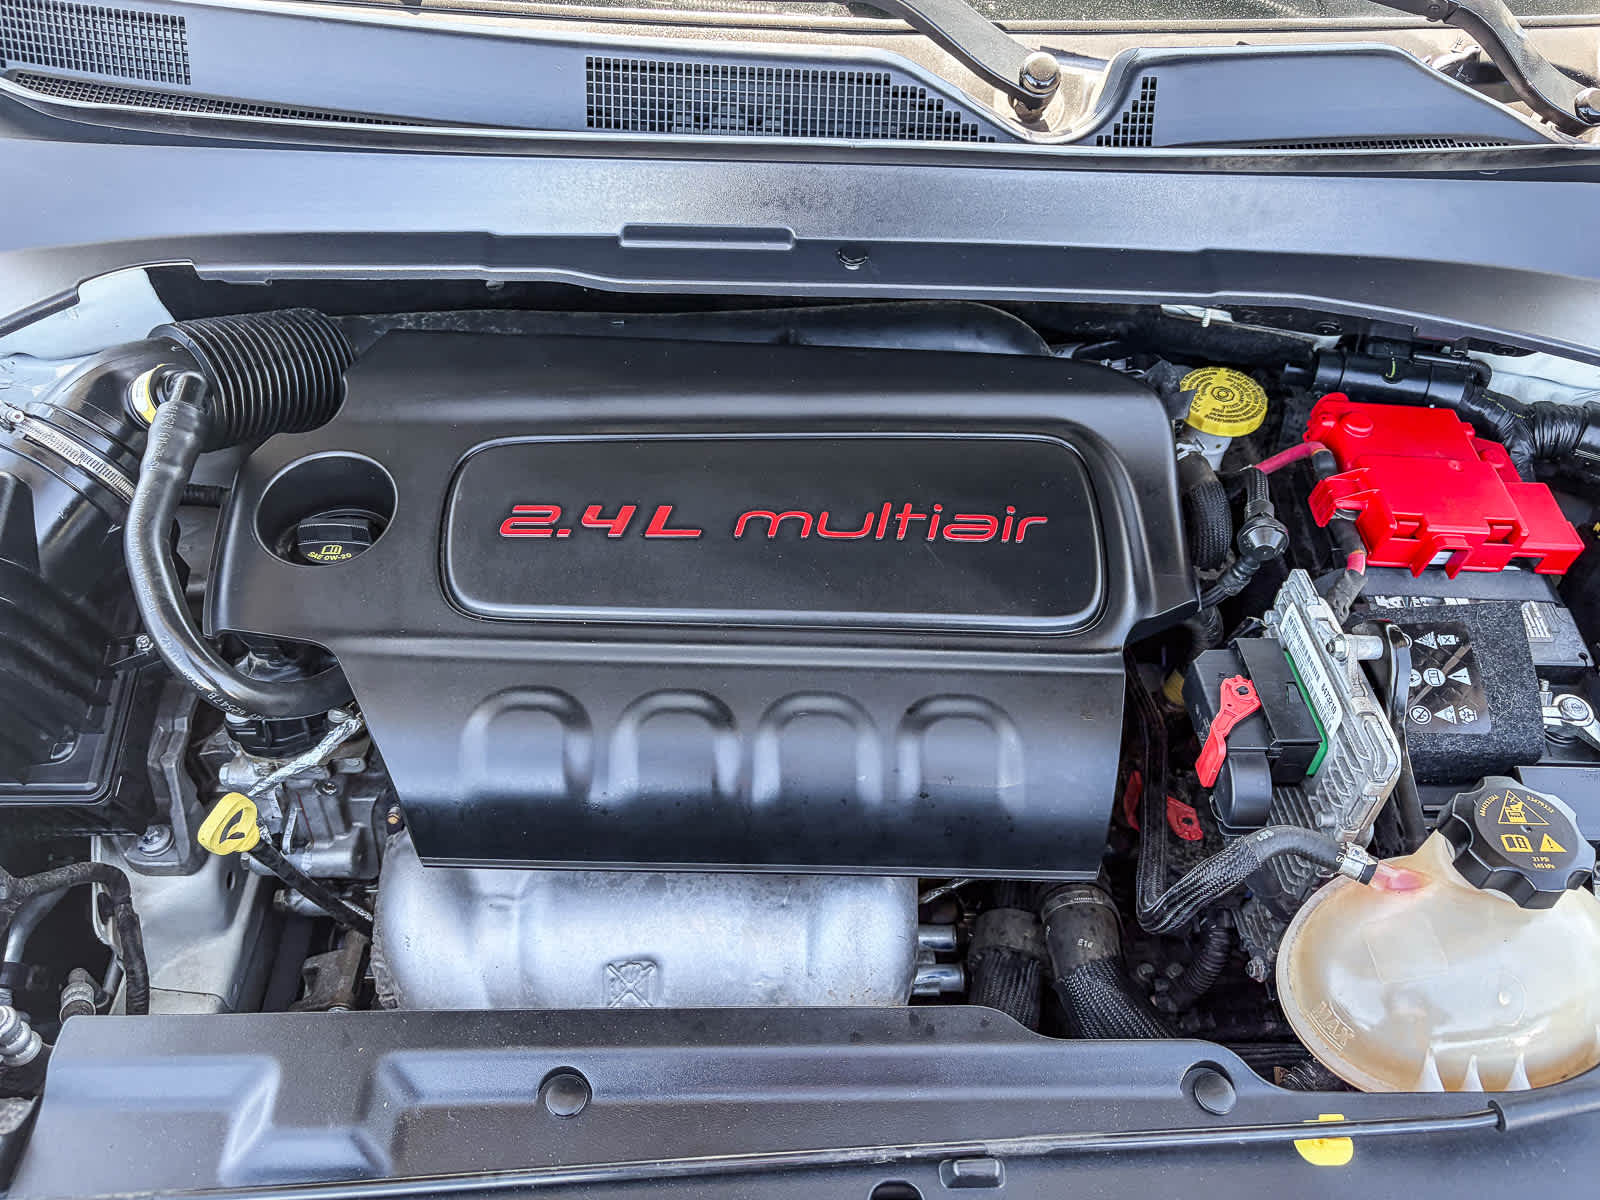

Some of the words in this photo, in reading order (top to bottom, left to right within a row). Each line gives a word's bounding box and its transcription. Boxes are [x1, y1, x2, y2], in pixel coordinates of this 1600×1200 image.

[734, 502, 1048, 543] multiair
[307, 551, 323, 560] SAE
[324, 552, 352, 561] 0W-20
